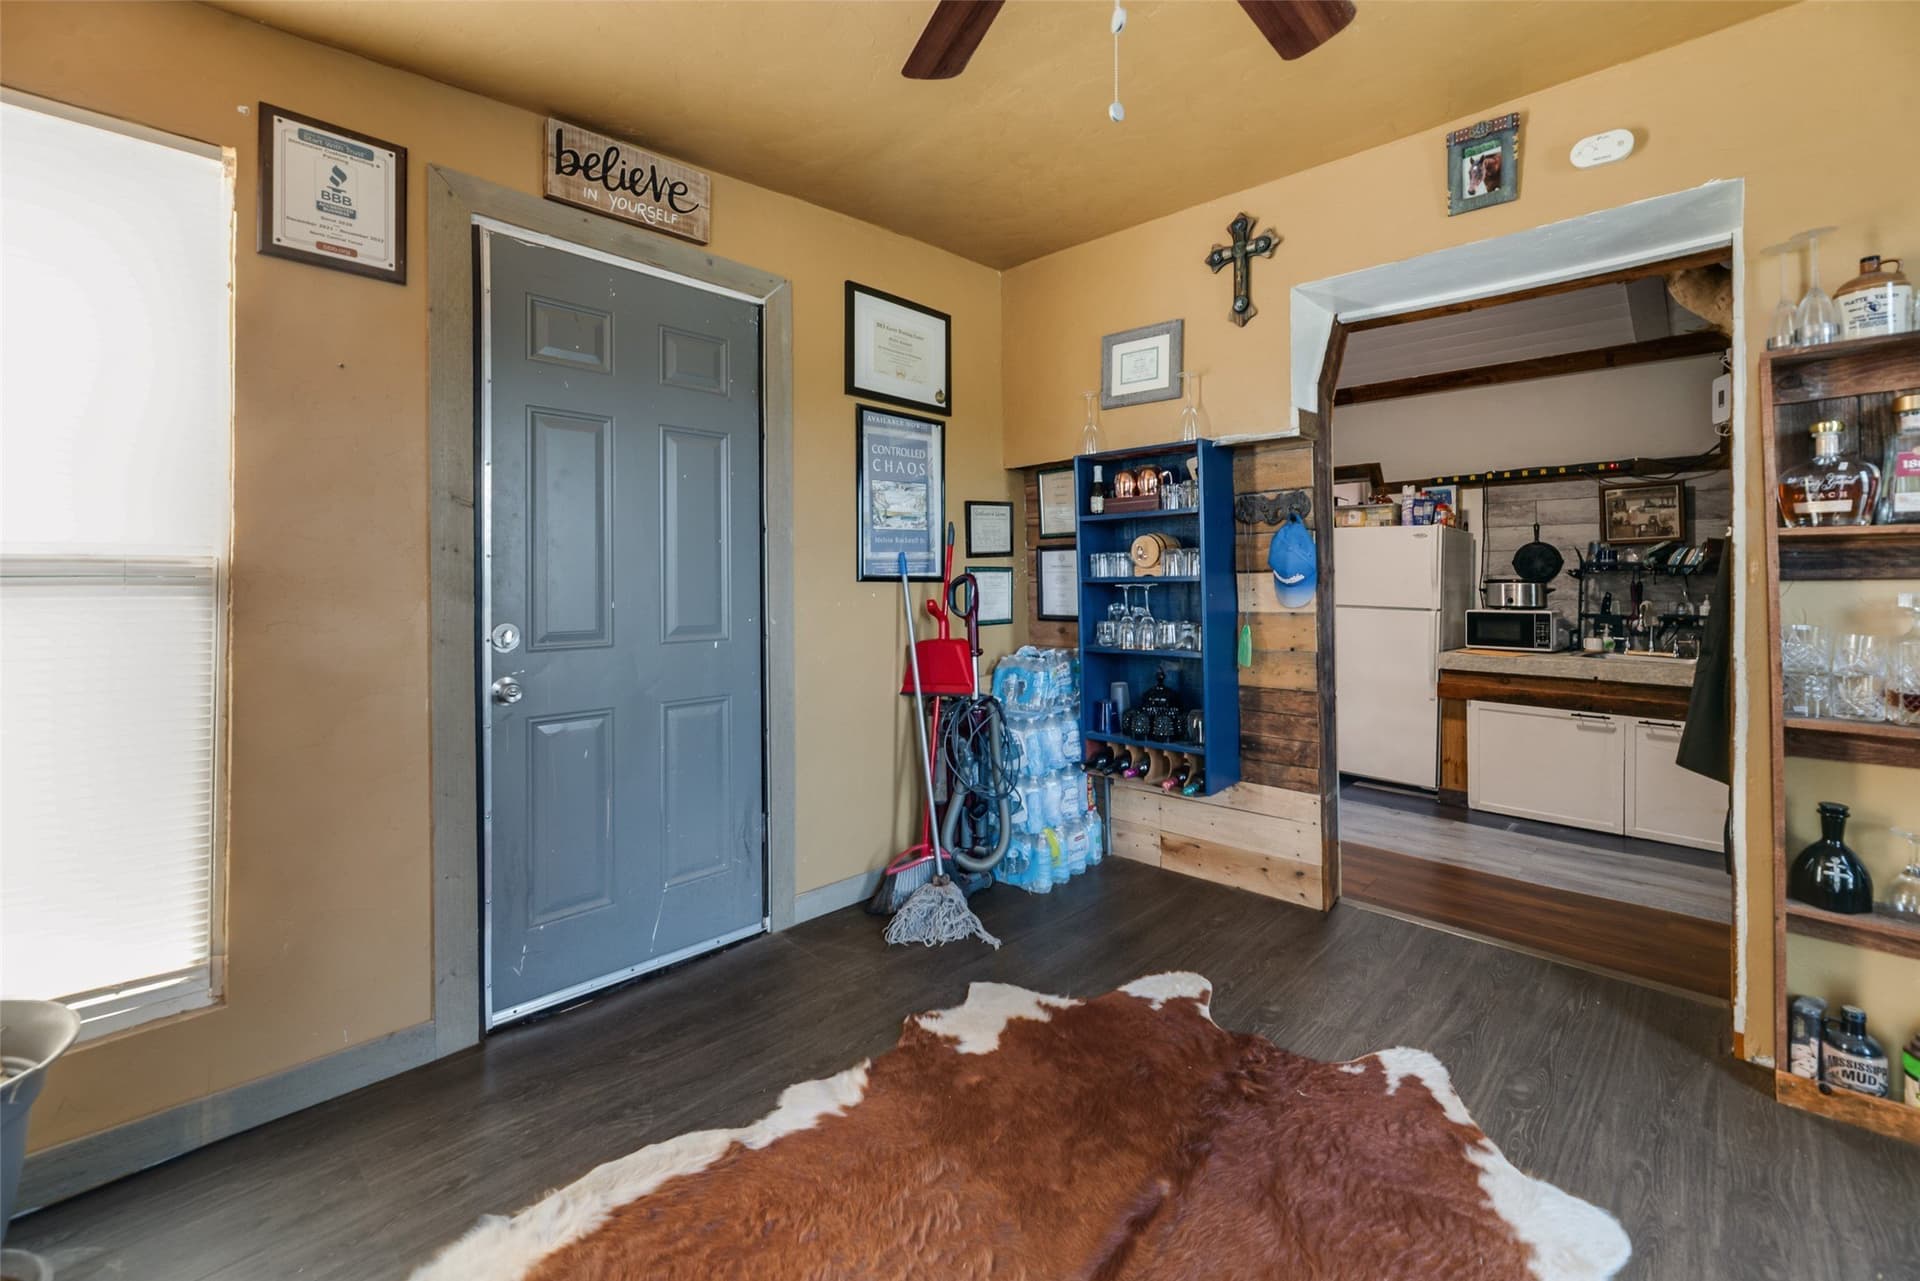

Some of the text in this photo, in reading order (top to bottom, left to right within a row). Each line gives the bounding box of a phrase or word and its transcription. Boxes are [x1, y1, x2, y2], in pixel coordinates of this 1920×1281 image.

[555, 128, 699, 214] believe
[321, 190, 353, 207] BBB
[583, 187, 680, 225] IN YOURSELF
[871, 444, 926, 459] CONTROLLED
[872, 458, 926, 477] CHAOS
[1841, 1069, 1878, 1086] MUD
